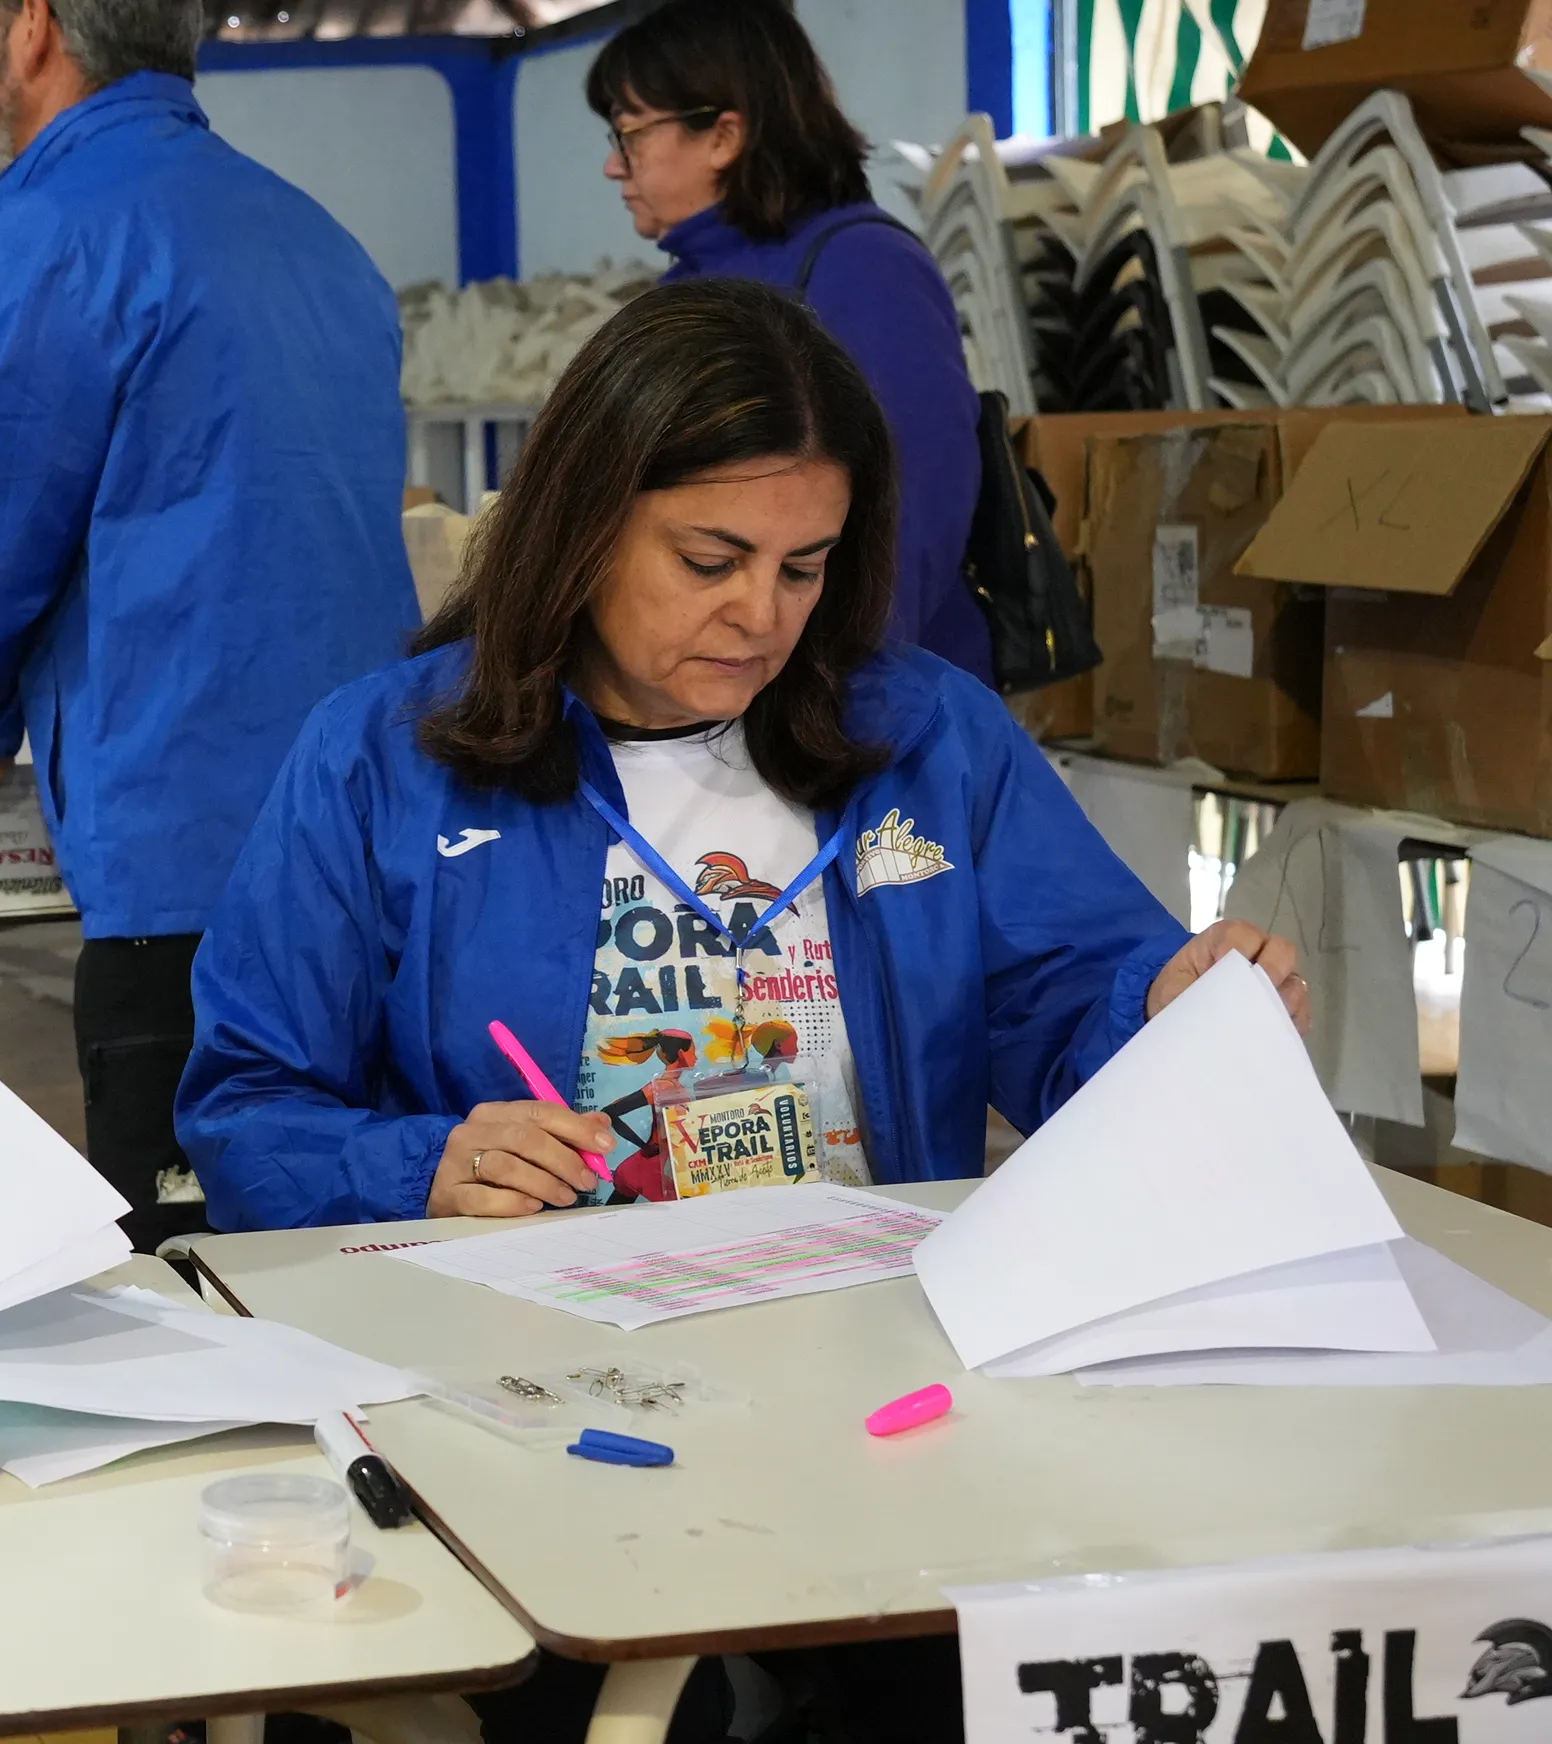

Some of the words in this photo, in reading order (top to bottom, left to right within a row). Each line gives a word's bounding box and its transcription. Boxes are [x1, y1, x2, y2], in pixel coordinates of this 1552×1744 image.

[1318, 468, 1412, 532] XL
[877, 809, 942, 869] Alegre
[900, 863, 939, 881] MONTORO
[602, 875, 645, 909] ORO
[788, 944, 795, 965] y
[803, 939, 832, 960] Rut
[589, 964, 723, 1017] RAIL
[742, 968, 838, 1002] Senderis
[698, 1115, 771, 1146] EPORA
[709, 1108, 745, 1124] MONTORO
[701, 1134, 774, 1166] TRAIL
[779, 1099, 798, 1170] VOLUNTARIOS
[688, 1158, 707, 1169] CXM
